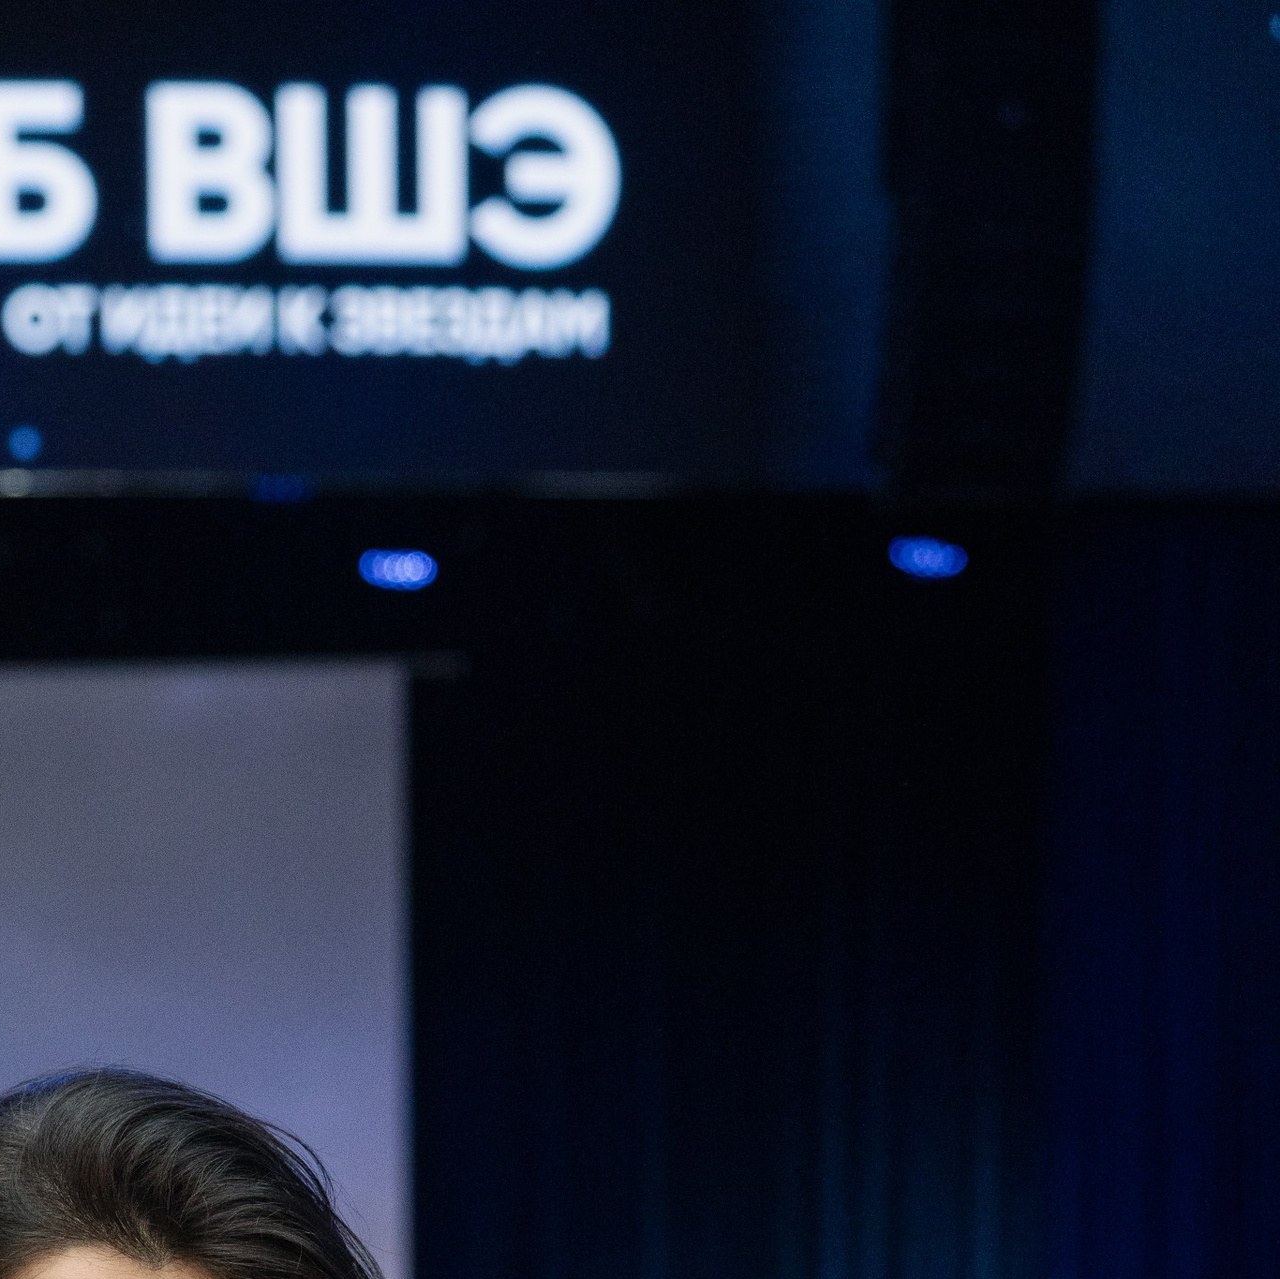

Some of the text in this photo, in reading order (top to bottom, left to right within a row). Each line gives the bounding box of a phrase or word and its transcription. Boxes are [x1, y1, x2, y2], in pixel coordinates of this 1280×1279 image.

[146, 81, 621, 270] ВШЭ
[2, 283, 97, 357] ОТ
[277, 284, 326, 357] К
[330, 285, 610, 366] ЗВЕЗДАМ
